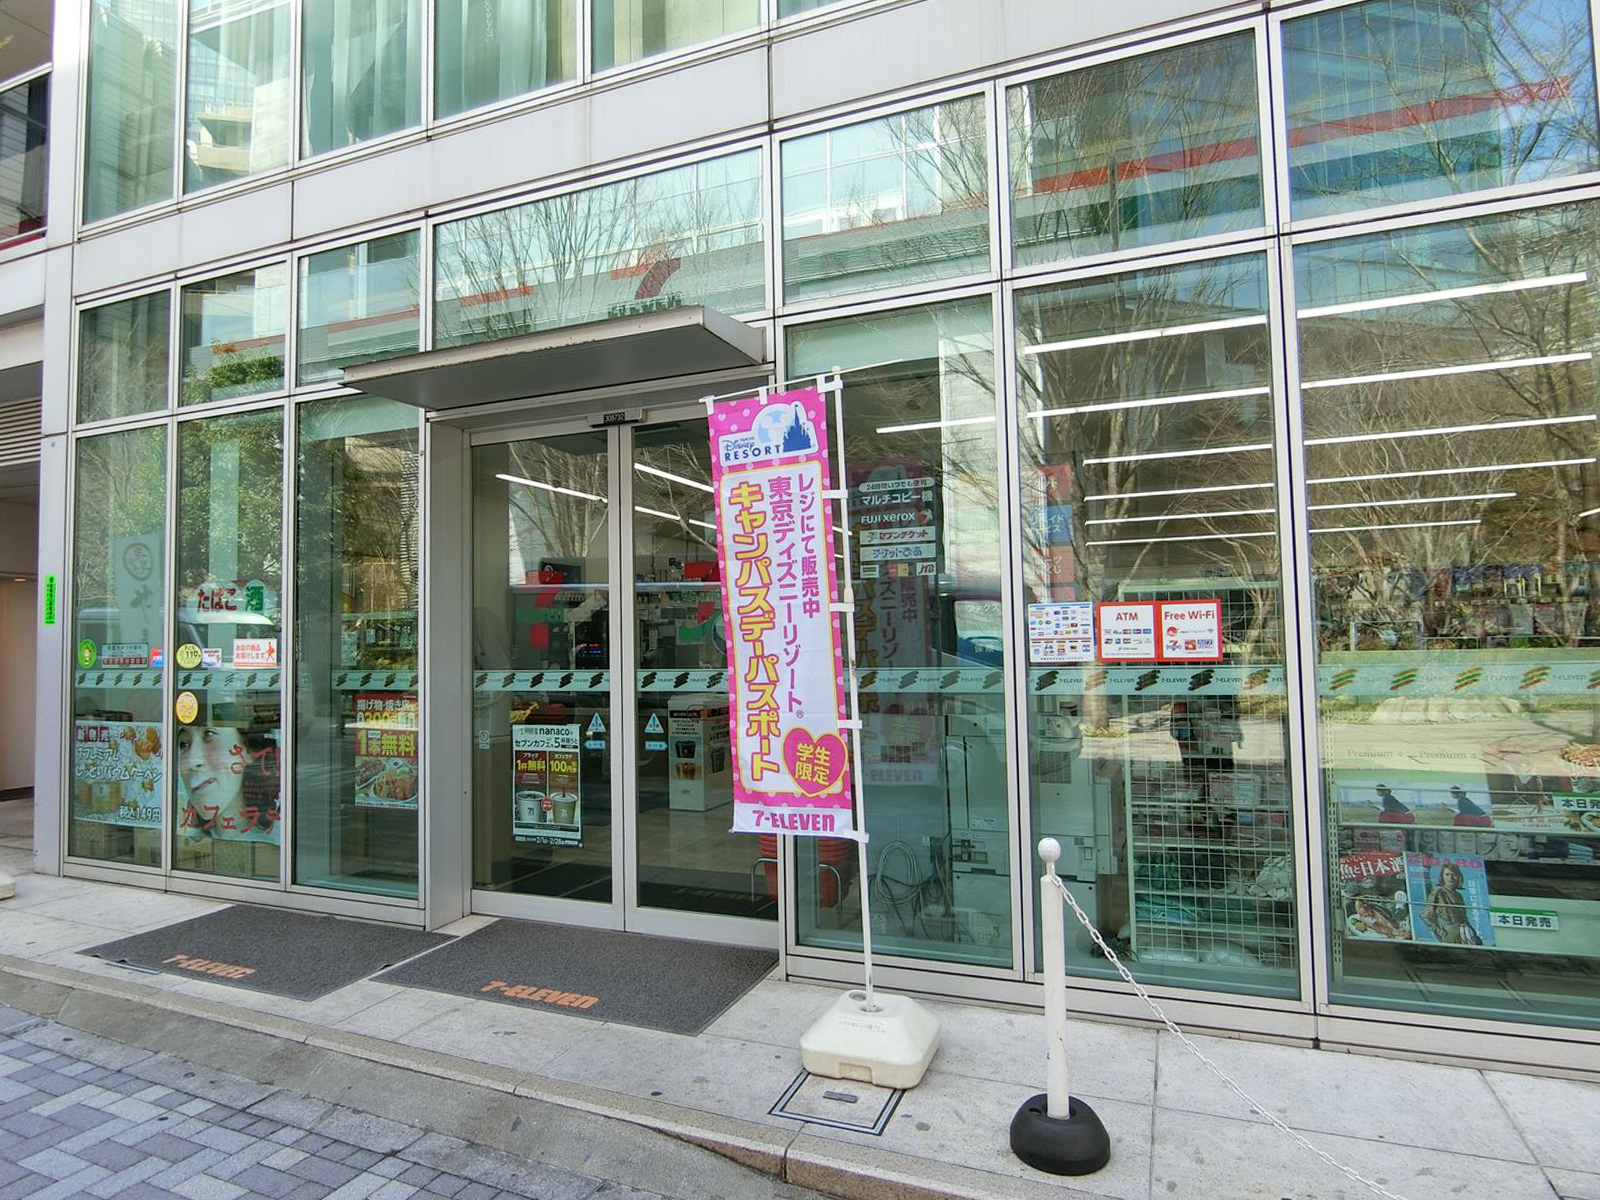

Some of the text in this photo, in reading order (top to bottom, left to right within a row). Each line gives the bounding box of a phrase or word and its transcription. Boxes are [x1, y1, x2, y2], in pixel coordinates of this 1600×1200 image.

[724, 444, 782, 462] RESORT
[861, 489, 933, 505] マルチコピー機
[860, 512, 916, 524] FUJI xerox
[798, 472, 820, 619] レジにて販売中
[197, 587, 237, 612] たばこ
[1115, 612, 1139, 621] ATM
[1164, 610, 1215, 620] Free Wi-Fi
[729, 481, 781, 782] キャンパスデーパスポート
[796, 743, 831, 767] 学生
[795, 763, 830, 786] 限定
[1497, 914, 1552, 928] 本日発売
